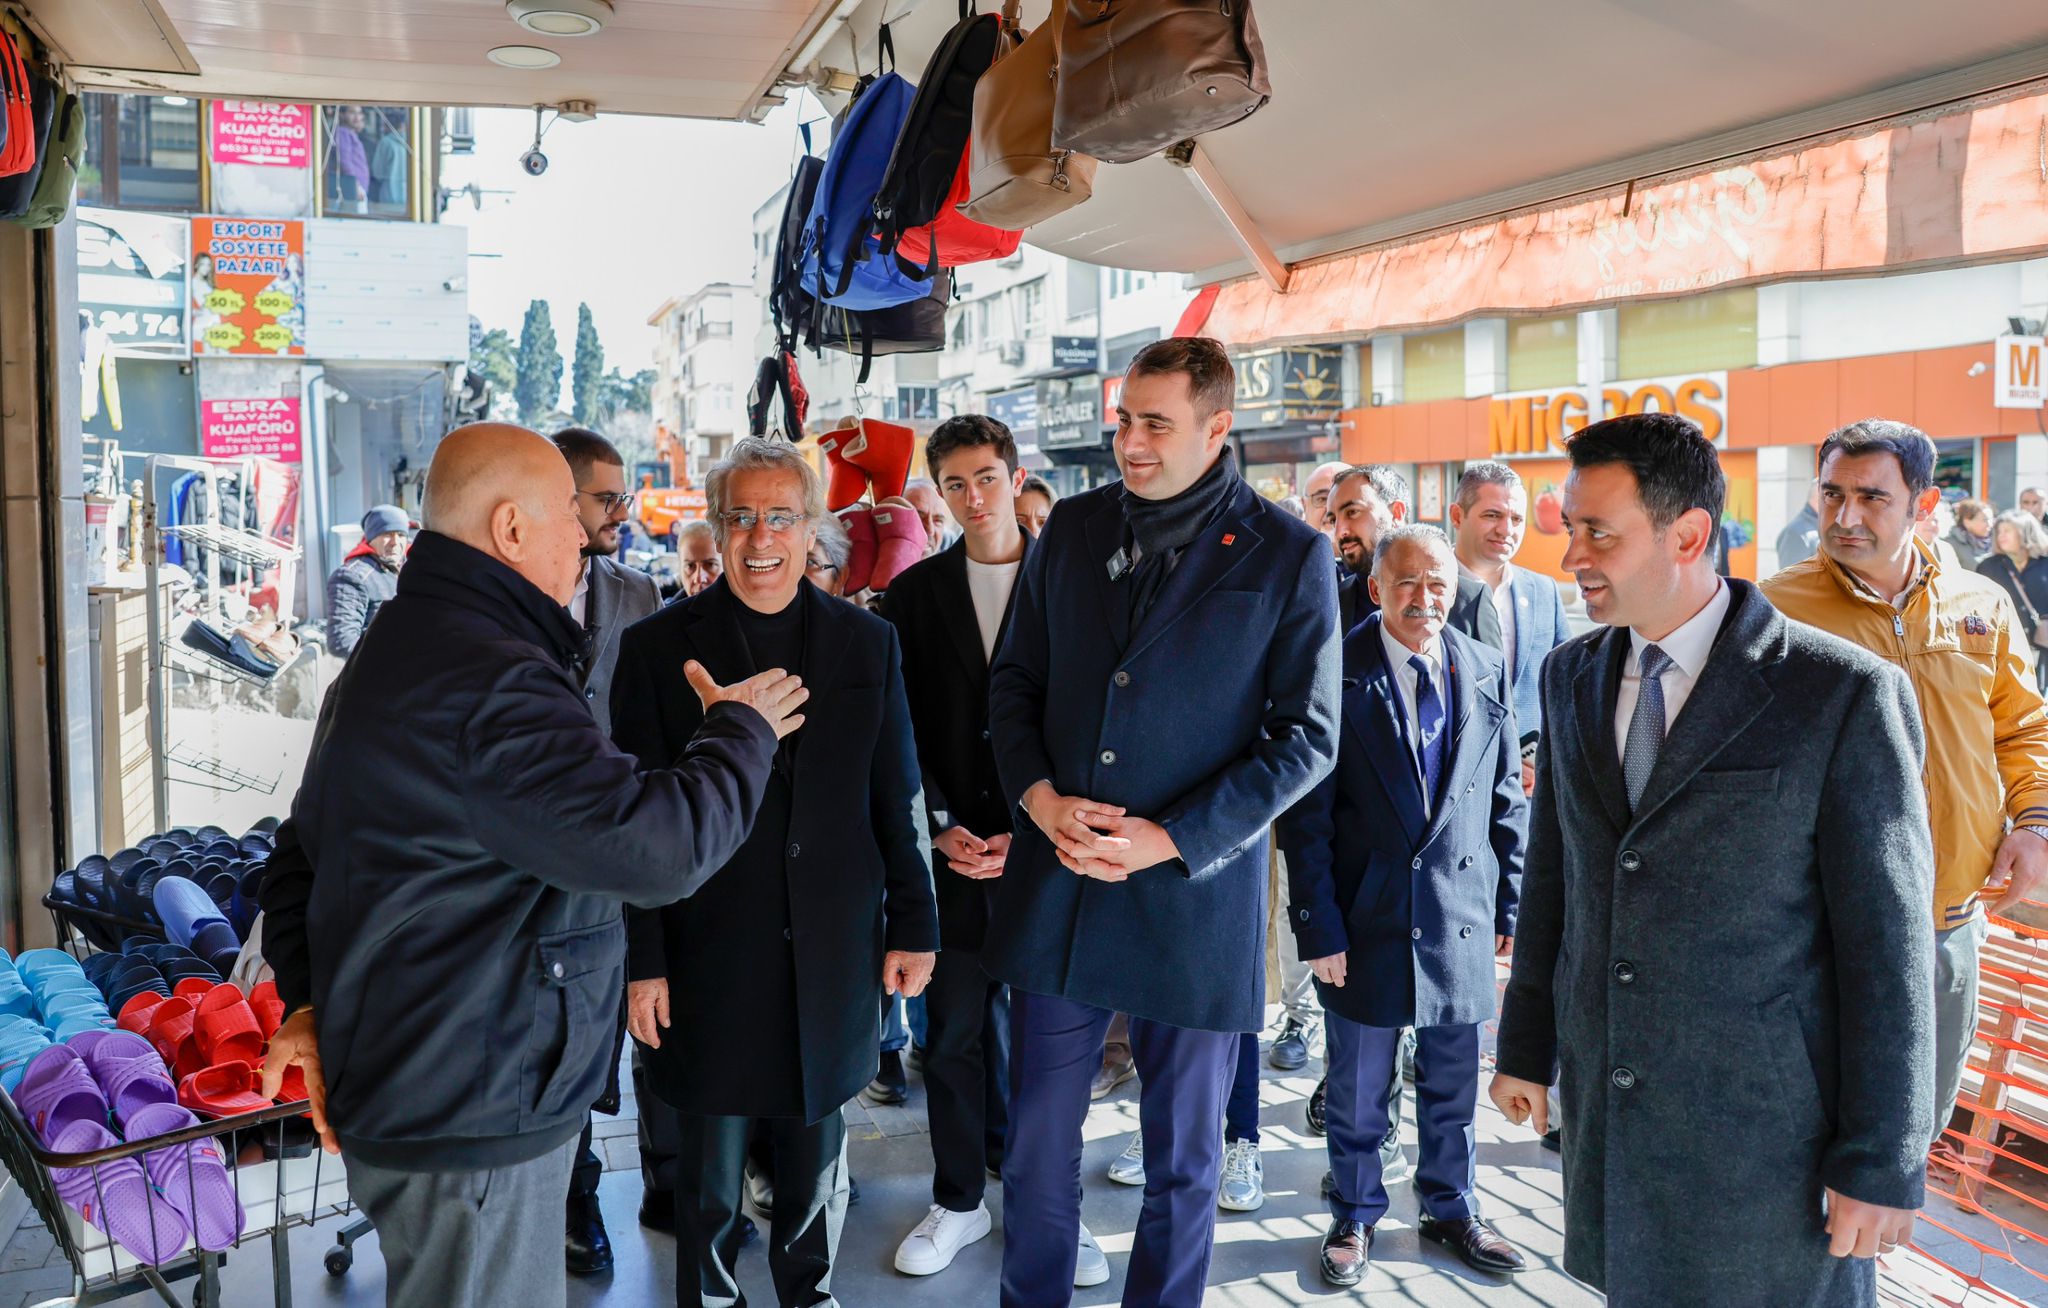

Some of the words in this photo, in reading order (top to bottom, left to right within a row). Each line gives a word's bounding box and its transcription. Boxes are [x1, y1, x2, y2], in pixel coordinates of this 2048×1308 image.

[223, 100, 301, 116] ESRA
[233, 112, 292, 124] BAYAN
[214, 222, 284, 238] EXPORT
[211, 240, 286, 256] SOSYETE
[217, 259, 281, 273] PAZARI
[210, 297, 227, 307] 50
[260, 297, 280, 307] 100
[100, 310, 138, 335] 24
[143, 313, 180, 336] 74
[209, 331, 229, 340] 150
[259, 331, 281, 340] 200
[2009, 344, 2039, 387] M
[212, 400, 291, 414] ESRA
[222, 412, 281, 422] BAYAN
[209, 419, 295, 436] KUAFÖRÜ
[1965, 616, 1987, 635] 95
